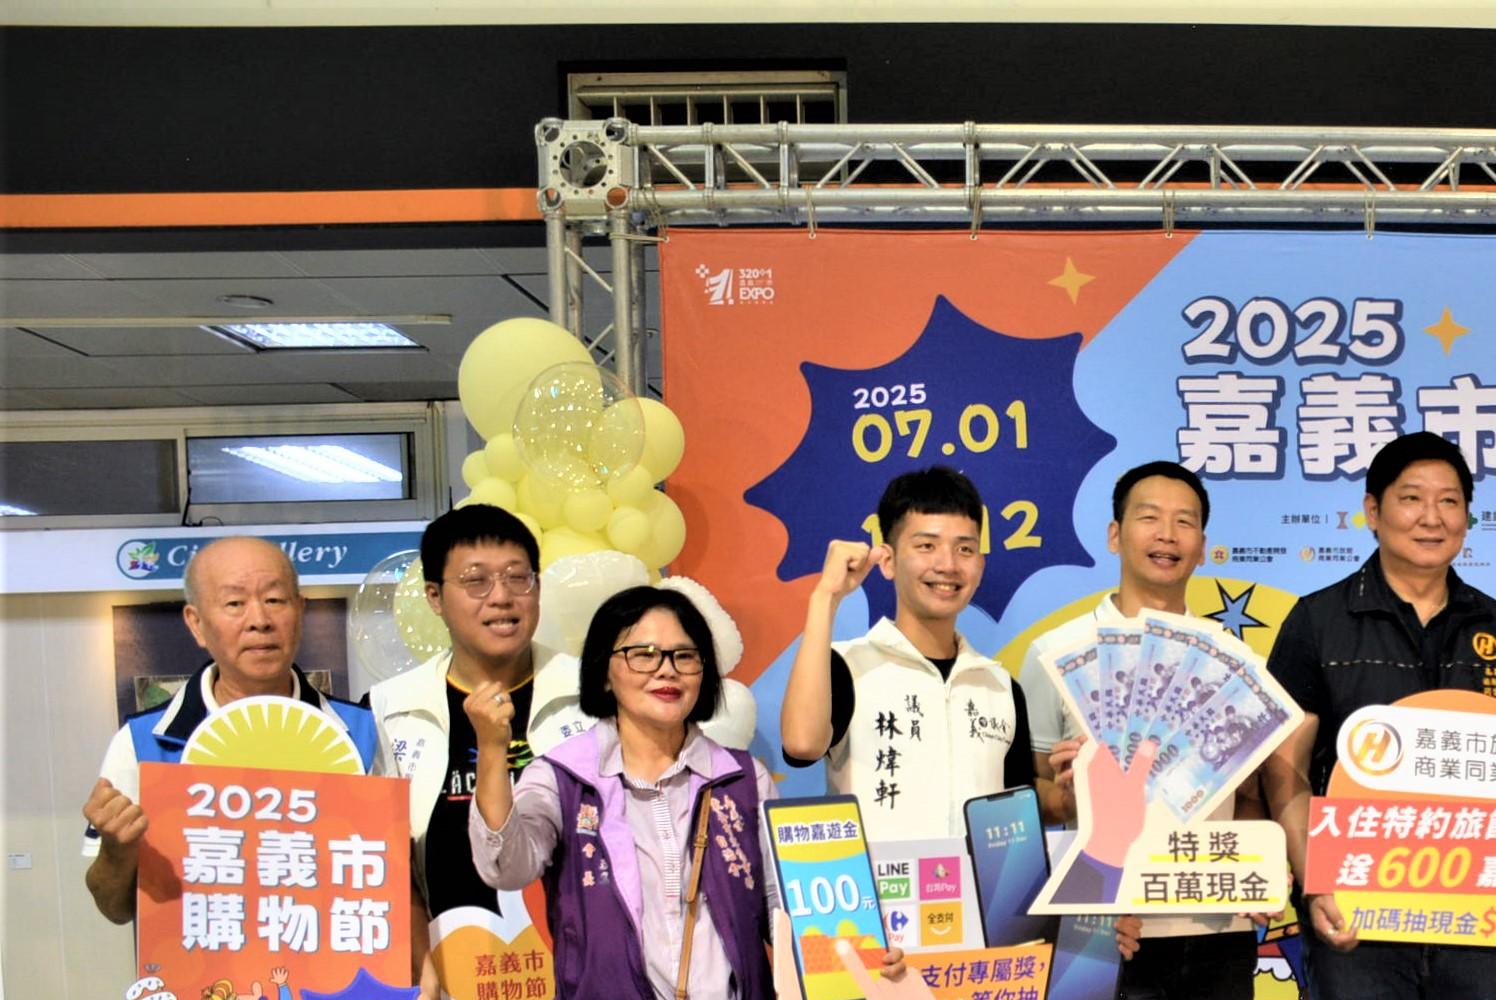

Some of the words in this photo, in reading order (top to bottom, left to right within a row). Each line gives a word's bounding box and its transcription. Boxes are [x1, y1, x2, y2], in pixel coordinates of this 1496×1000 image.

[739, 287, 775, 300] EXPO
[1182, 296, 1404, 364] 2025
[853, 383, 927, 409] 2025
[852, 400, 1029, 463] 07.01
[874, 710, 903, 809] 林煒軒
[186, 783, 319, 823] 2025
[777, 820, 859, 845] 購物嘉遊金
[1168, 831, 1240, 862] 特獎
[182, 826, 388, 889] 嘉義市
[878, 862, 909, 877] LINE
[879, 880, 908, 895] Pay
[1140, 871, 1270, 904] 百萬現金
[182, 891, 391, 954] 購物節
[927, 912, 954, 923] 全支付
[474, 949, 545, 976] 嘉義市
